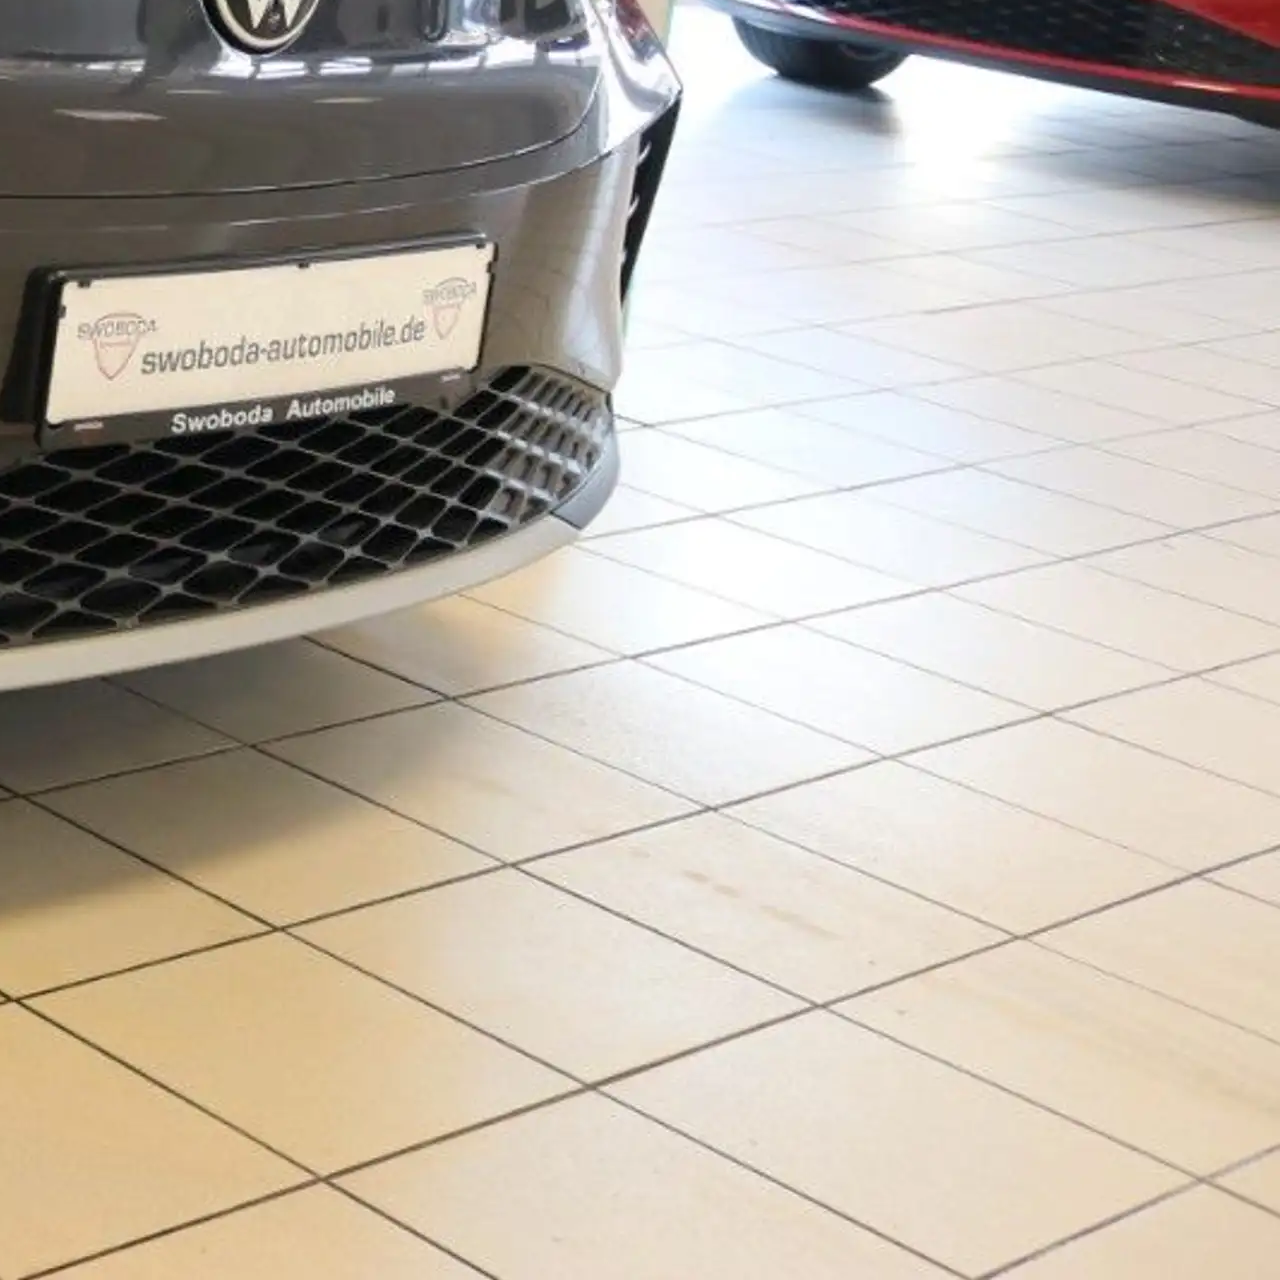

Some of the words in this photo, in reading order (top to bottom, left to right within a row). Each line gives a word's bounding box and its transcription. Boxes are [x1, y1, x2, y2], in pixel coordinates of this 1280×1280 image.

[140, 314, 427, 376] swoboda-automobile.de
[170, 405, 274, 435] Swoboda
[285, 385, 397, 421] Automobile
